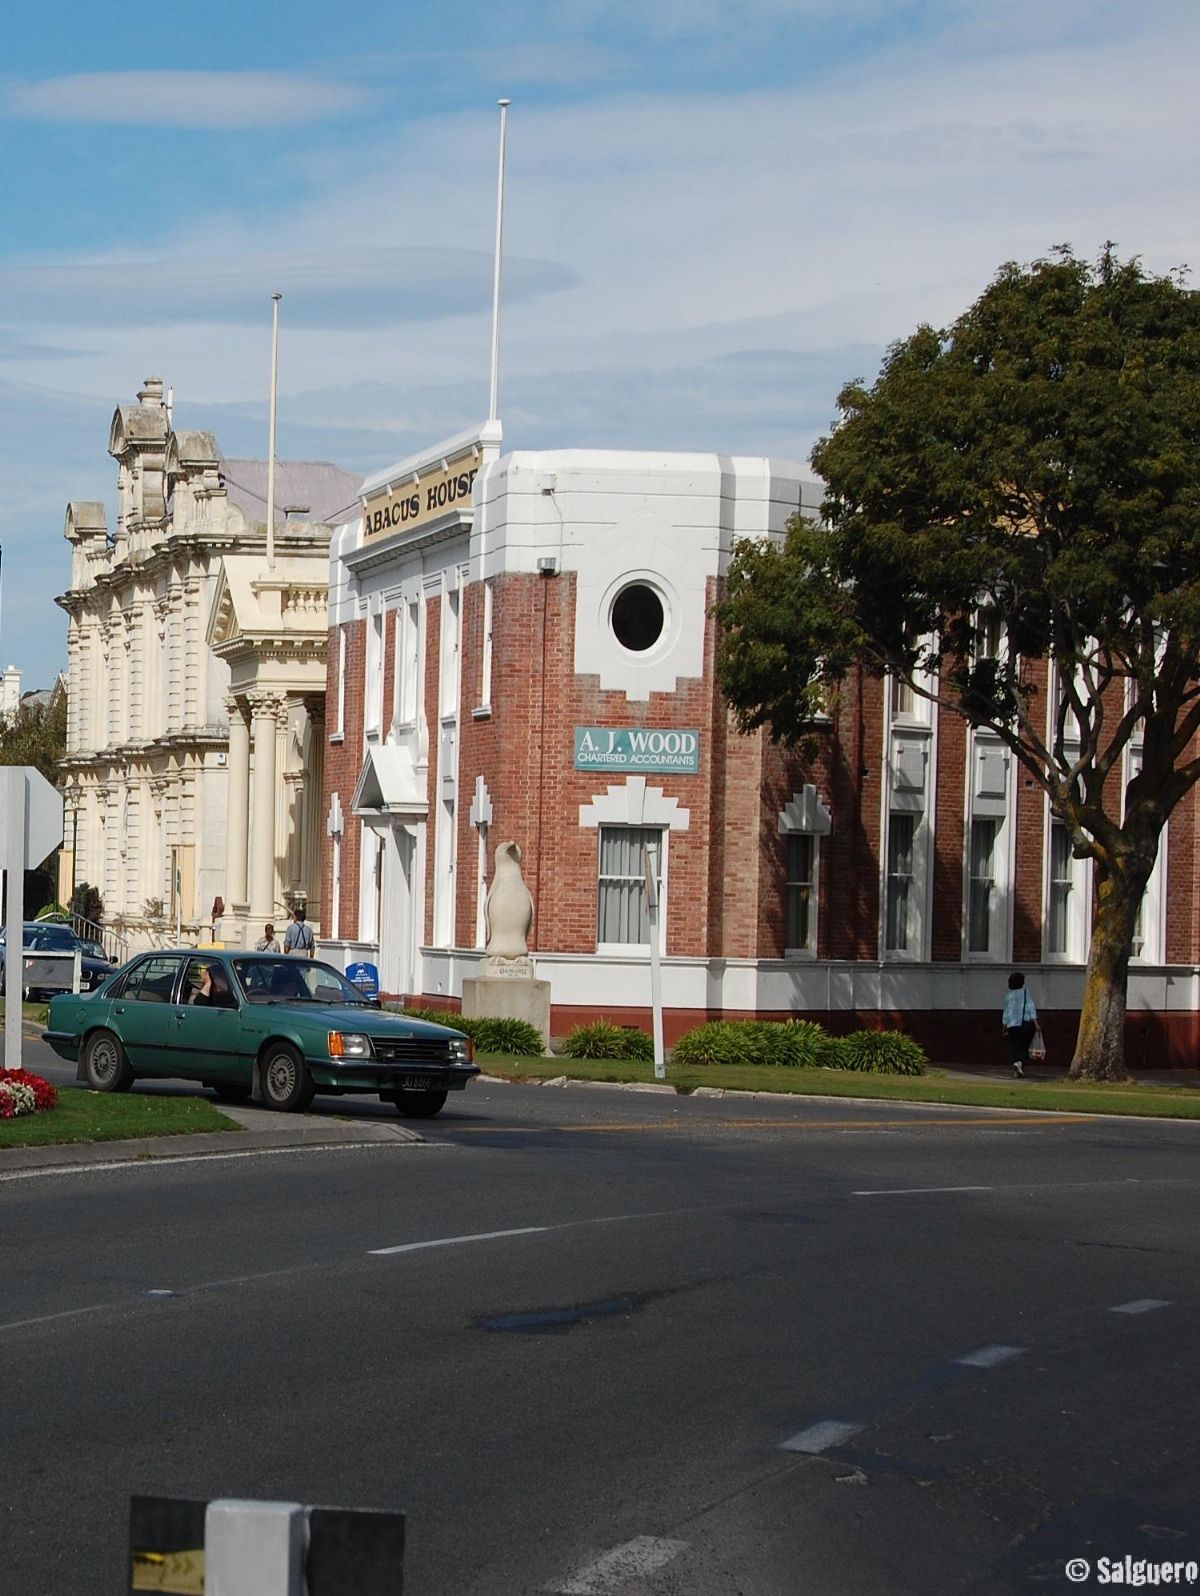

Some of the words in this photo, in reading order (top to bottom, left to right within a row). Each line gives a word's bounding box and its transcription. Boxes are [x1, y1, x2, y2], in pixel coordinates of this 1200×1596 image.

[364, 494, 420, 536] ABACUS
[580, 731, 599, 751] A.
[606, 731, 622, 754] J.
[628, 731, 696, 754] WOOD
[577, 752, 626, 763] CHARTERED
[630, 754, 695, 765] ACCOUNTANTS
